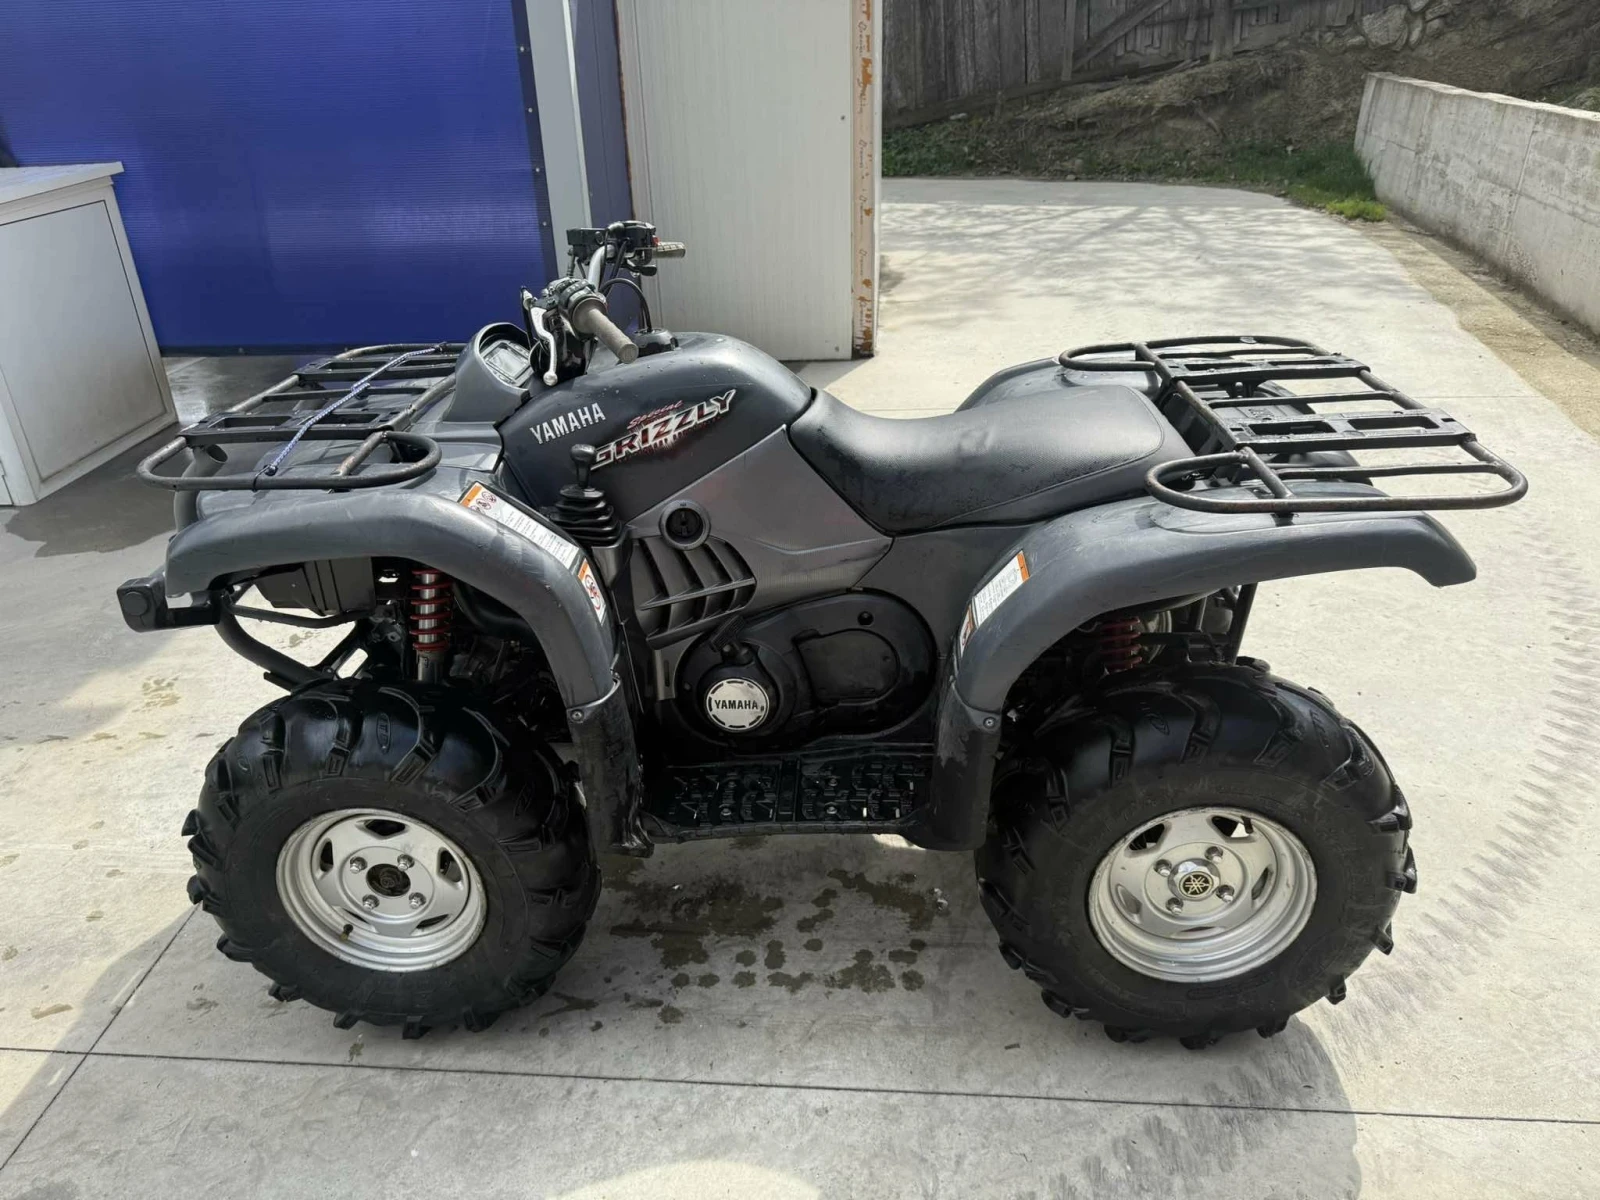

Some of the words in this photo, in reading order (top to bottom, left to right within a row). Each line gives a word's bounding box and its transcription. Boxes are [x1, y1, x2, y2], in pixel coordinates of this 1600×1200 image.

[530, 402, 606, 445] YAMAHA
[590, 388, 737, 471] GRIZZLY
[714, 699, 759, 710] YAMAHA
